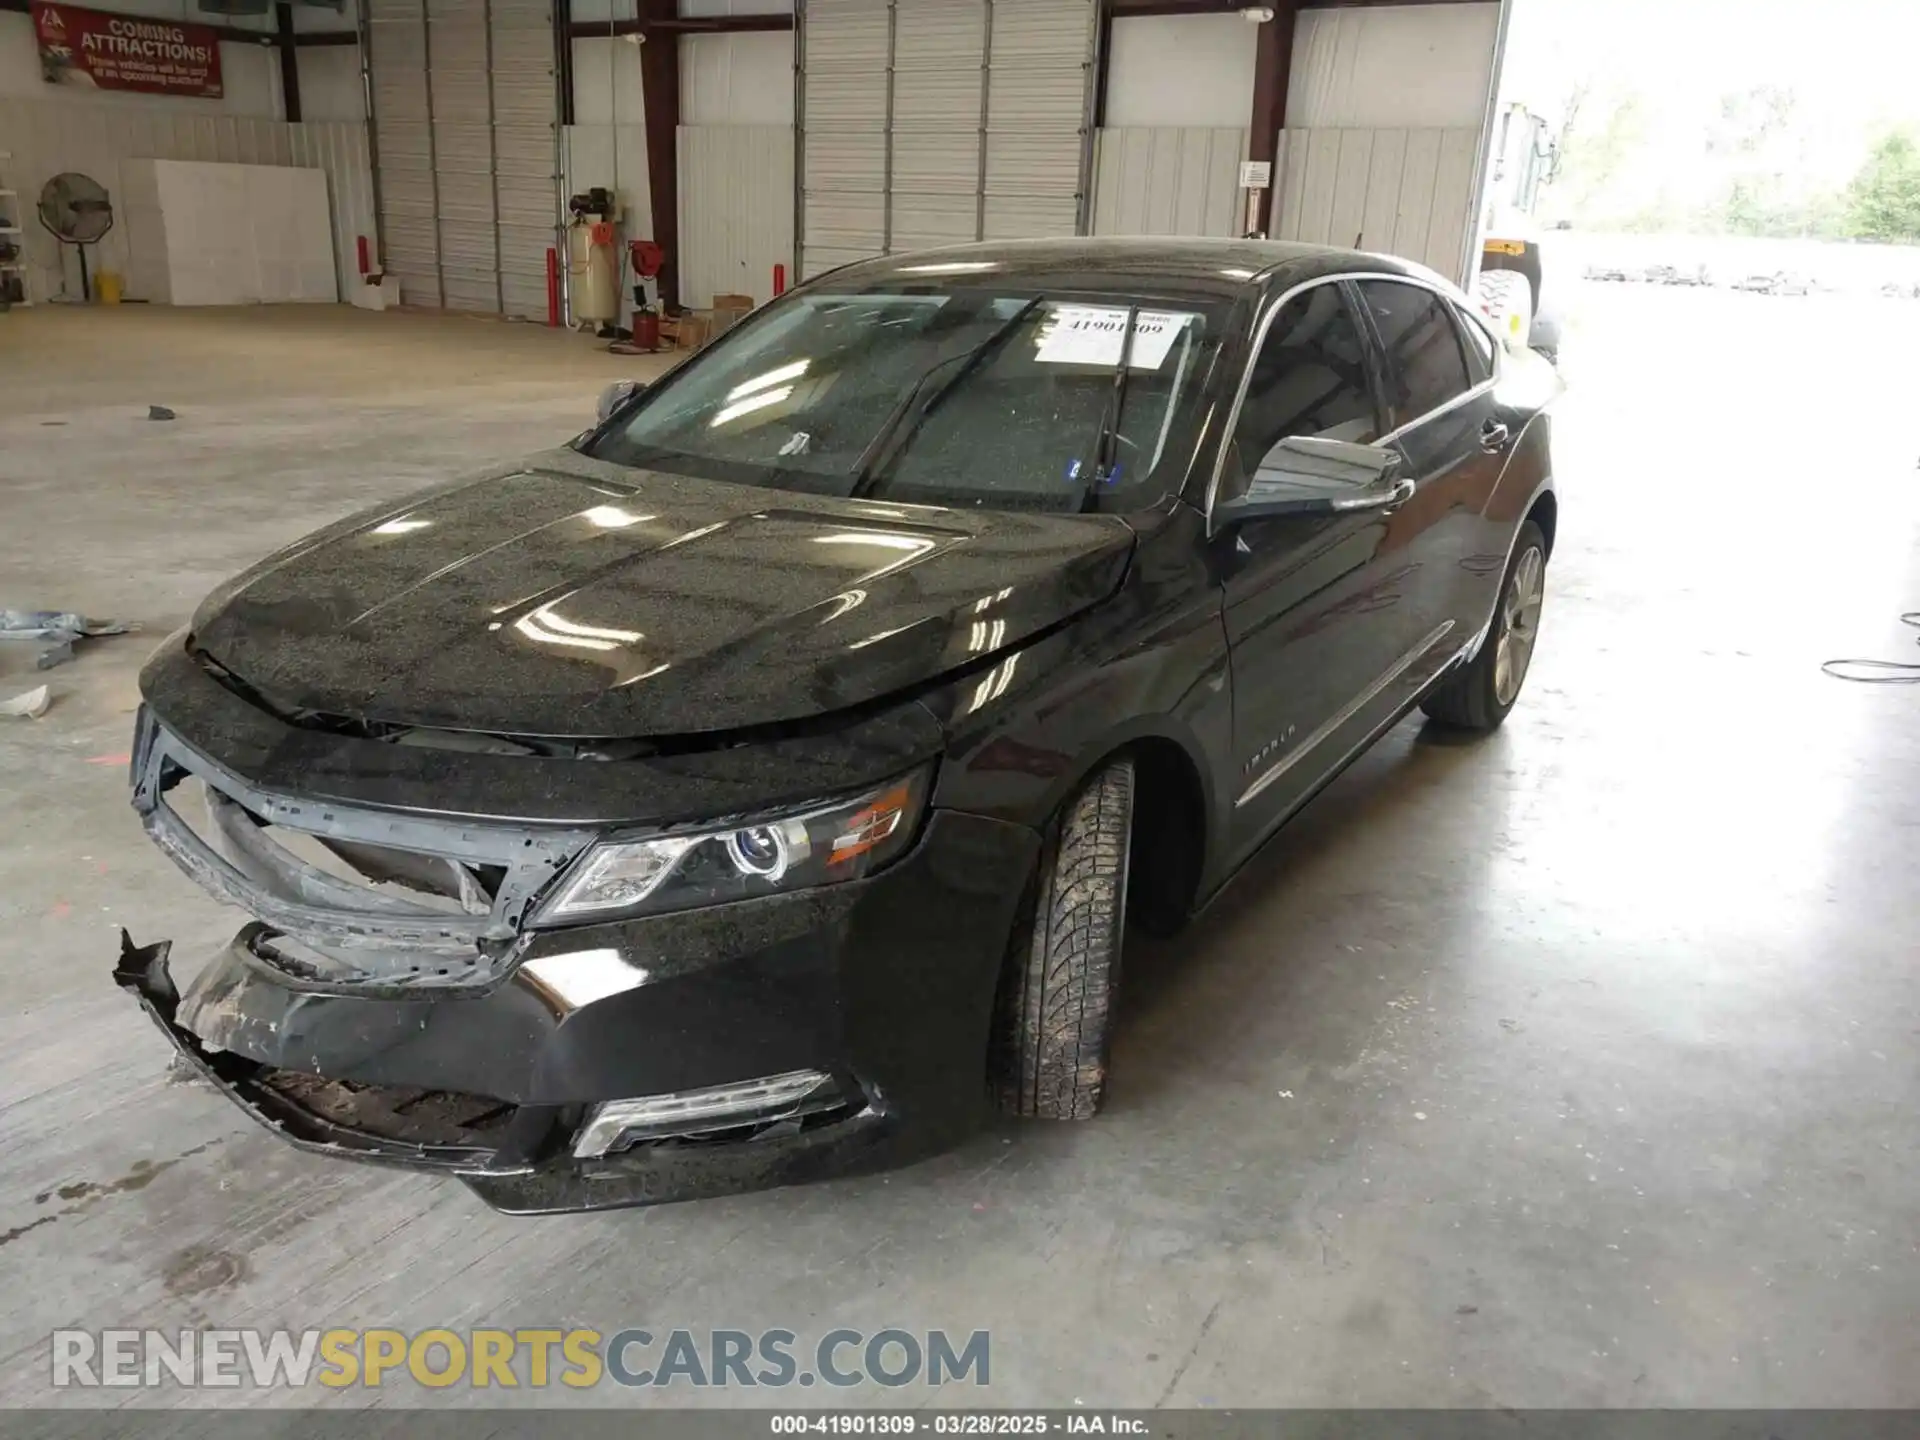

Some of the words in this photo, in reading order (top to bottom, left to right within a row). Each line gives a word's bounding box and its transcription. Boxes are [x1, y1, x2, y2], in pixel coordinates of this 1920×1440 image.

[108, 19, 185, 44] COMING
[81, 32, 213, 64] ATTRACTIONS!
[1244, 723, 1295, 774] IMPALA
